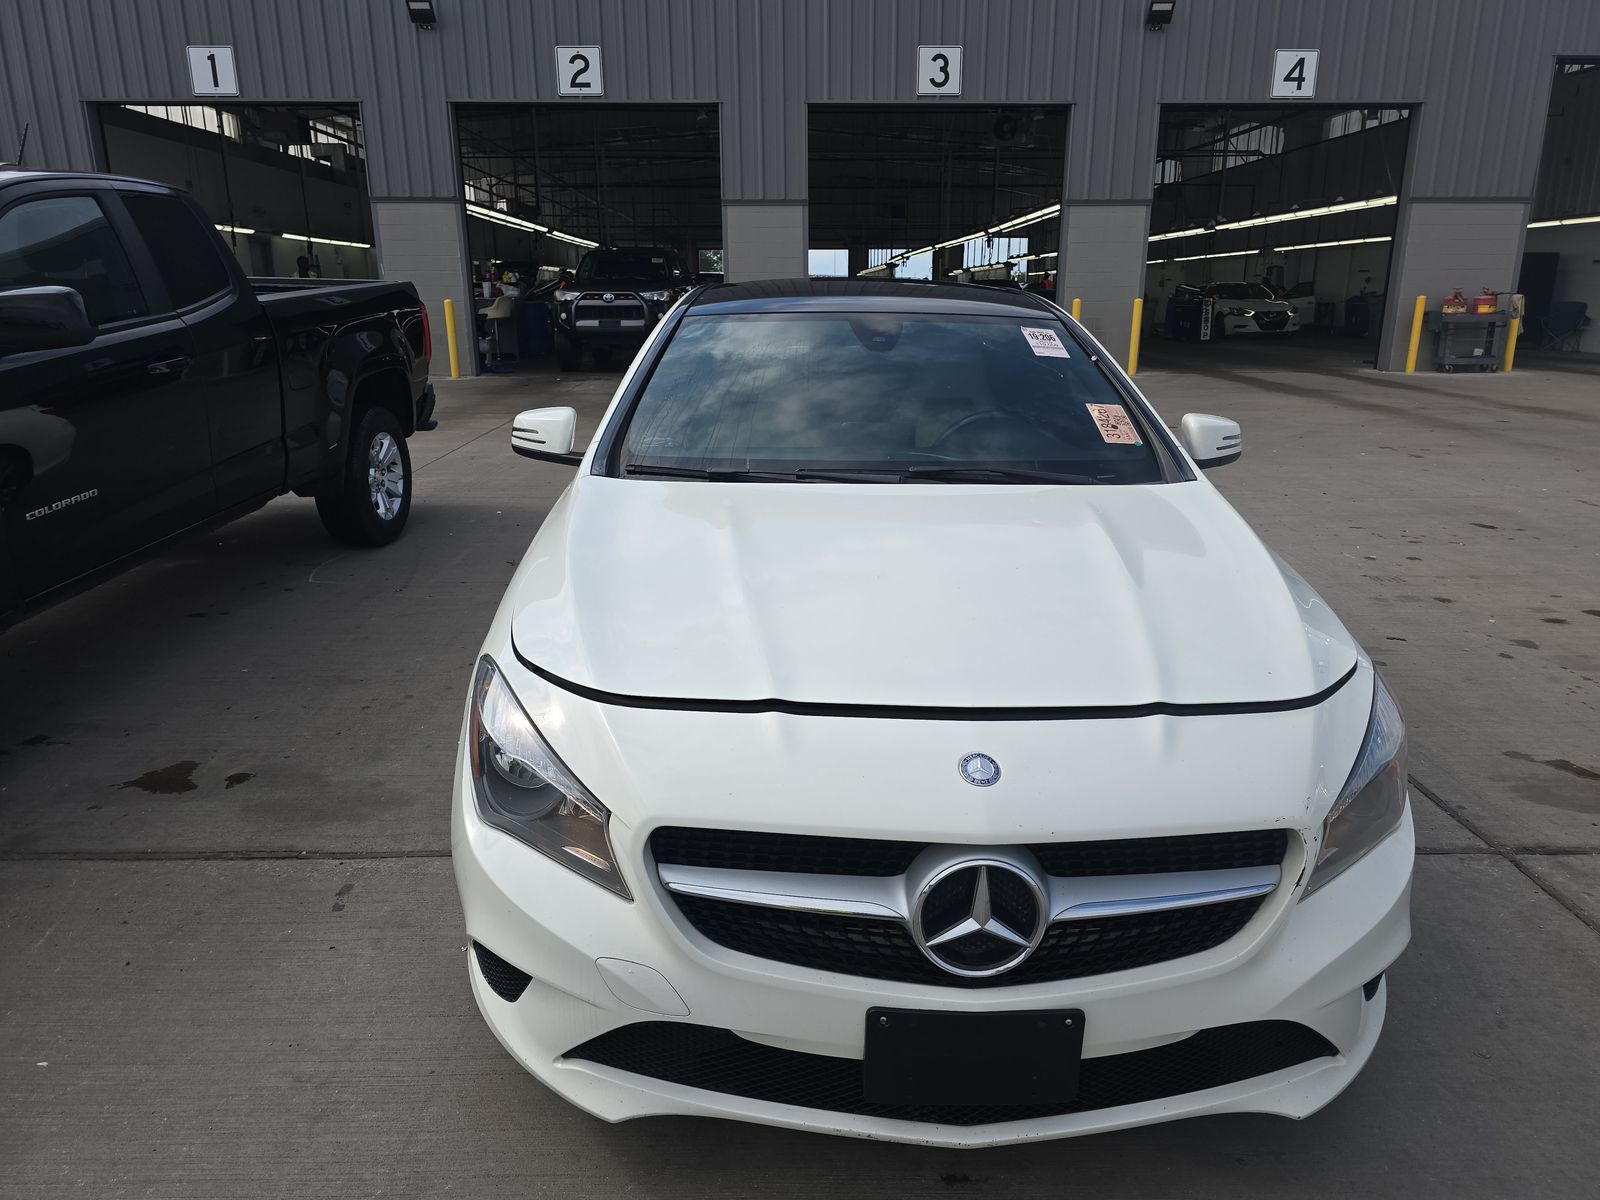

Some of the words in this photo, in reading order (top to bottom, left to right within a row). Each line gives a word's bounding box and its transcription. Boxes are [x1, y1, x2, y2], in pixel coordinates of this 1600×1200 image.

[207, 54, 219, 88] 1
[569, 54, 591, 88] 2
[929, 53, 950, 88] 3
[1283, 57, 1305, 91] 4
[25, 488, 99, 521] COLORADO
